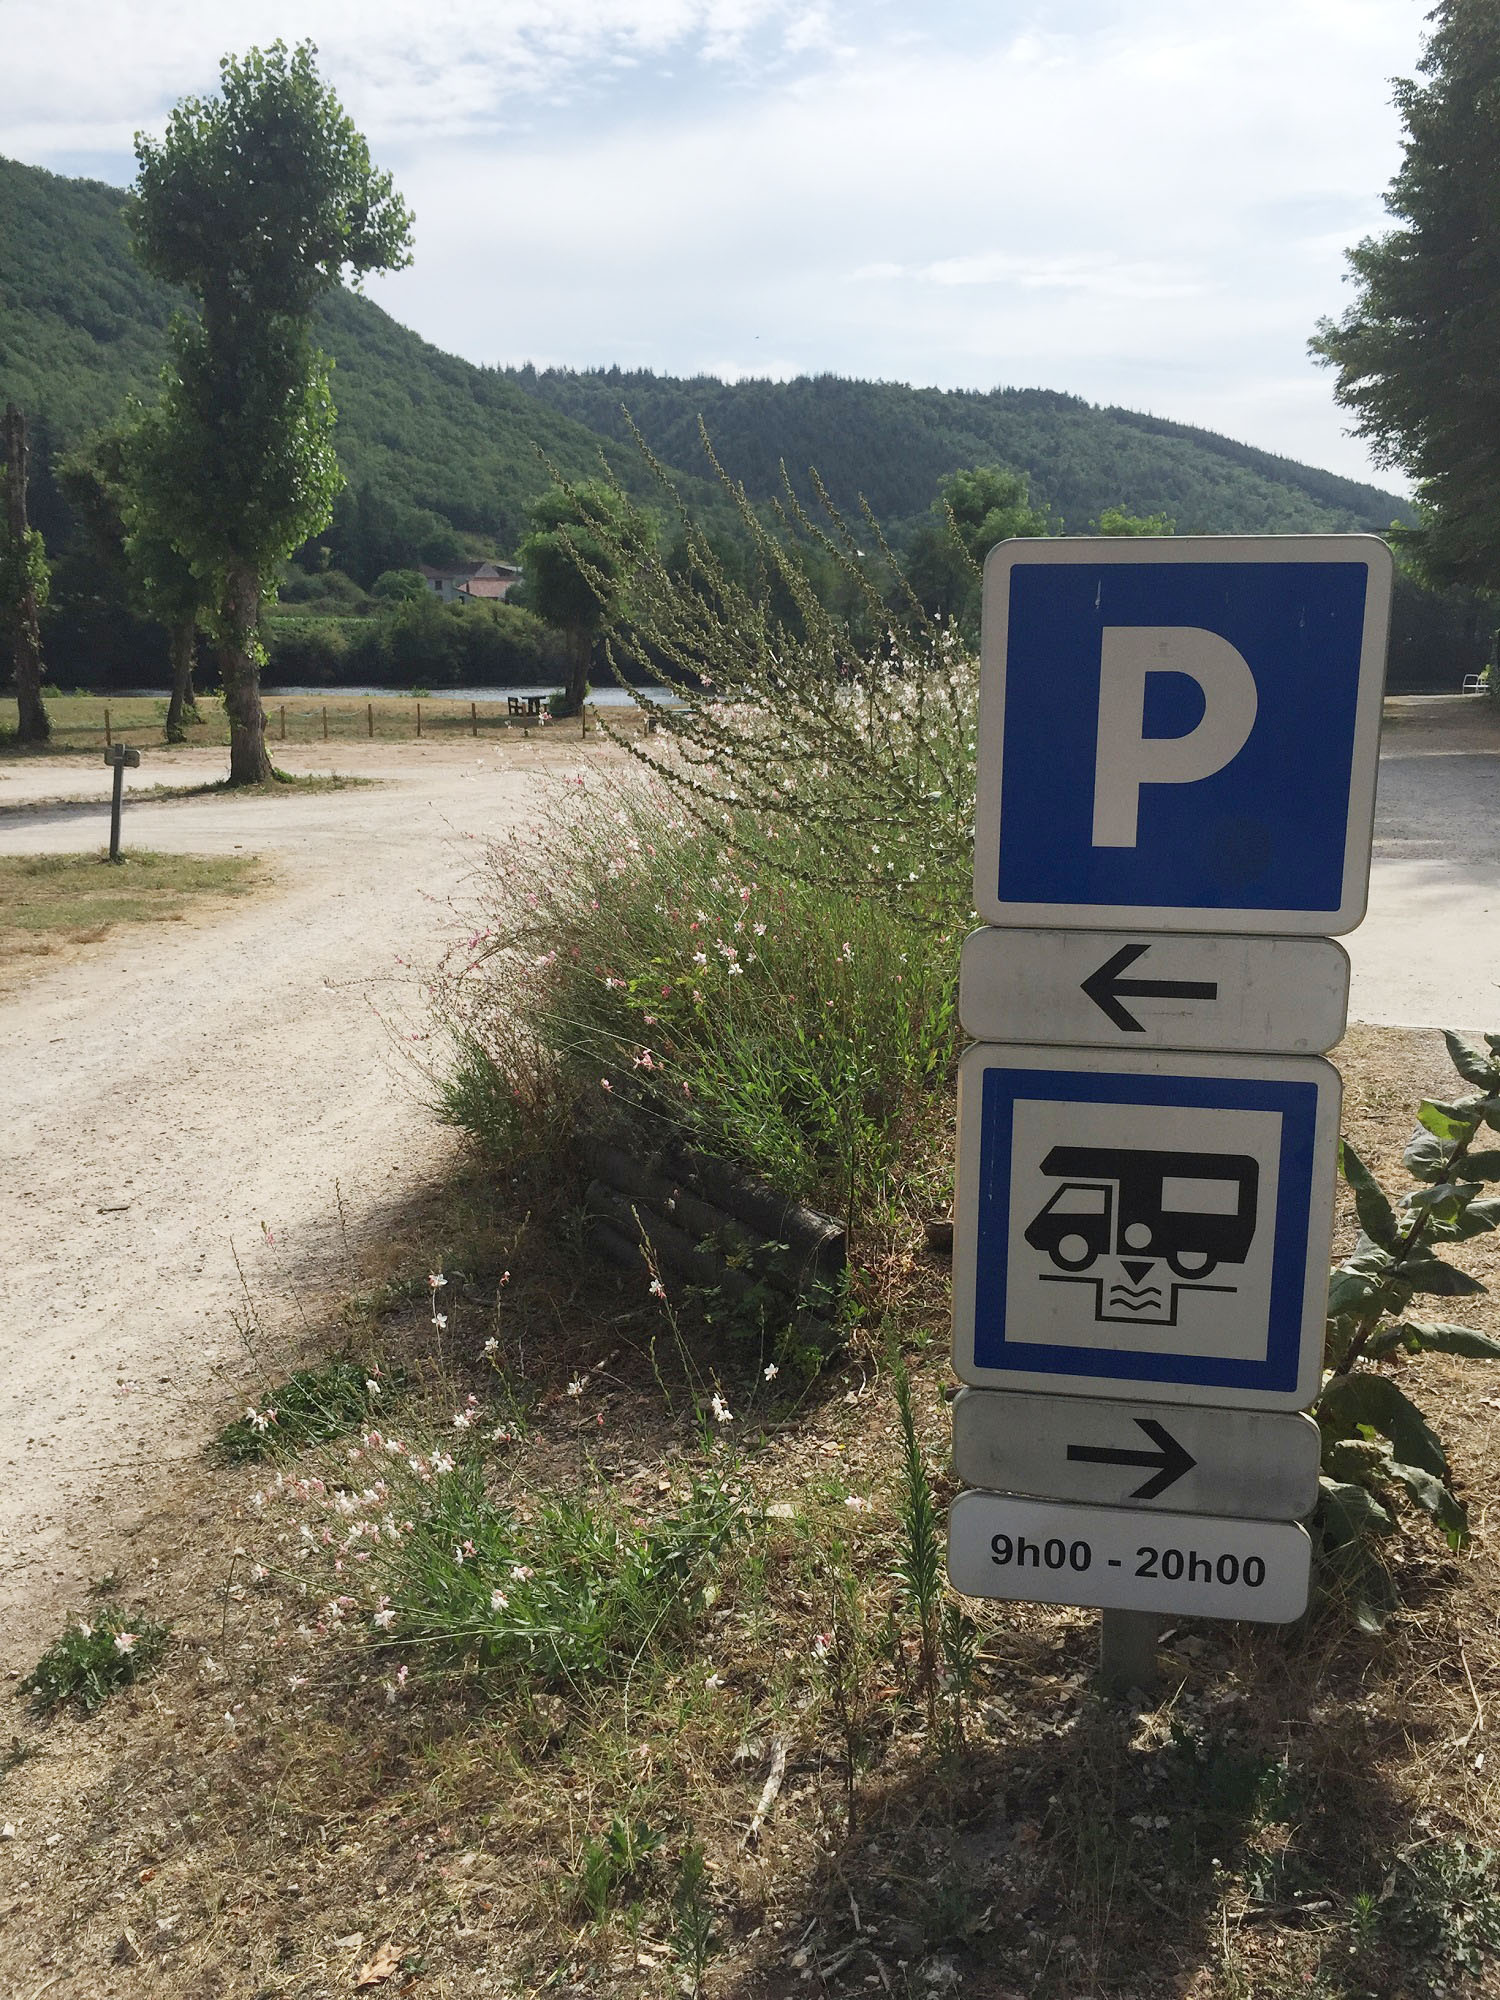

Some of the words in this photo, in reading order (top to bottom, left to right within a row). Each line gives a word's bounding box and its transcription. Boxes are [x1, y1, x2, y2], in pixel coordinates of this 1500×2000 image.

[1091, 626, 1259, 848] P
[990, 1533, 1092, 1572] 9h00
[1134, 1546, 1267, 1588] 20h00
